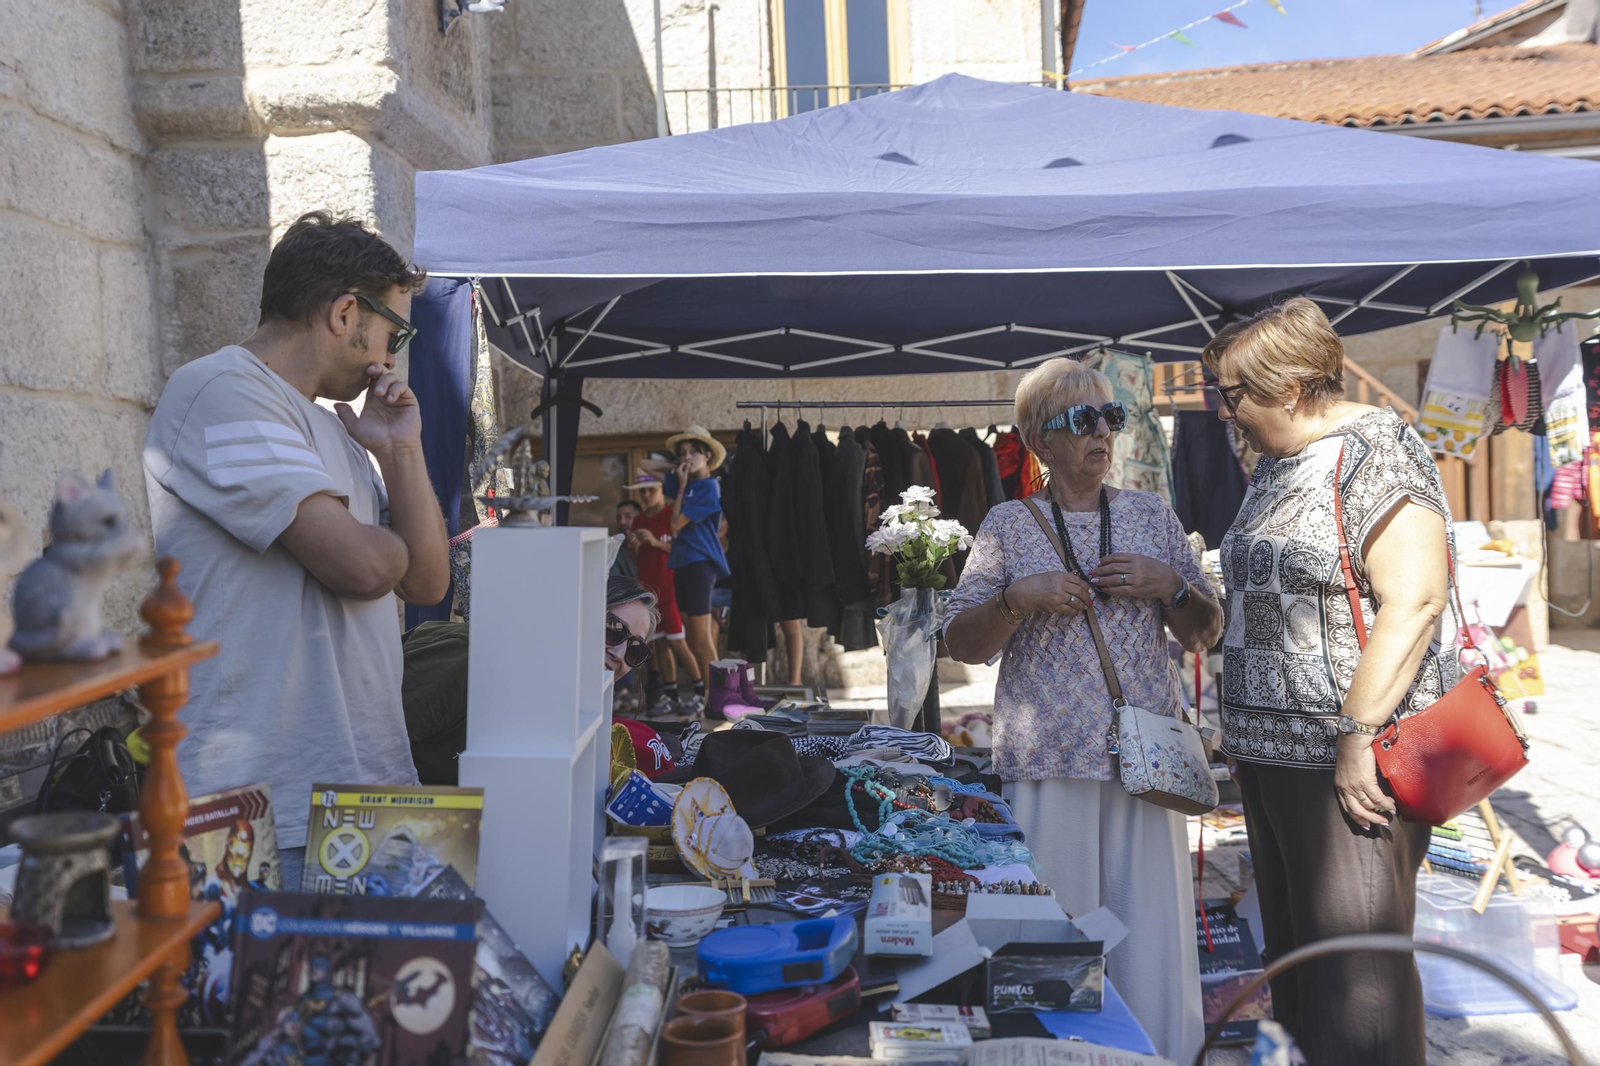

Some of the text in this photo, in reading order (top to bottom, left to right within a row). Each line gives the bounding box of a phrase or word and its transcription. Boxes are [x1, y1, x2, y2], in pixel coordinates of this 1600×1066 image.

[360, 795, 435, 806] GRANT MORRISON
[183, 806, 240, 827] NDES BATALLAS
[323, 809, 375, 828] NEW
[315, 875, 366, 895] MEN
[251, 912, 278, 933] DC
[1227, 924, 1239, 933] de
[881, 935, 915, 946] Modern
[993, 985, 1034, 995] PUNTAS
